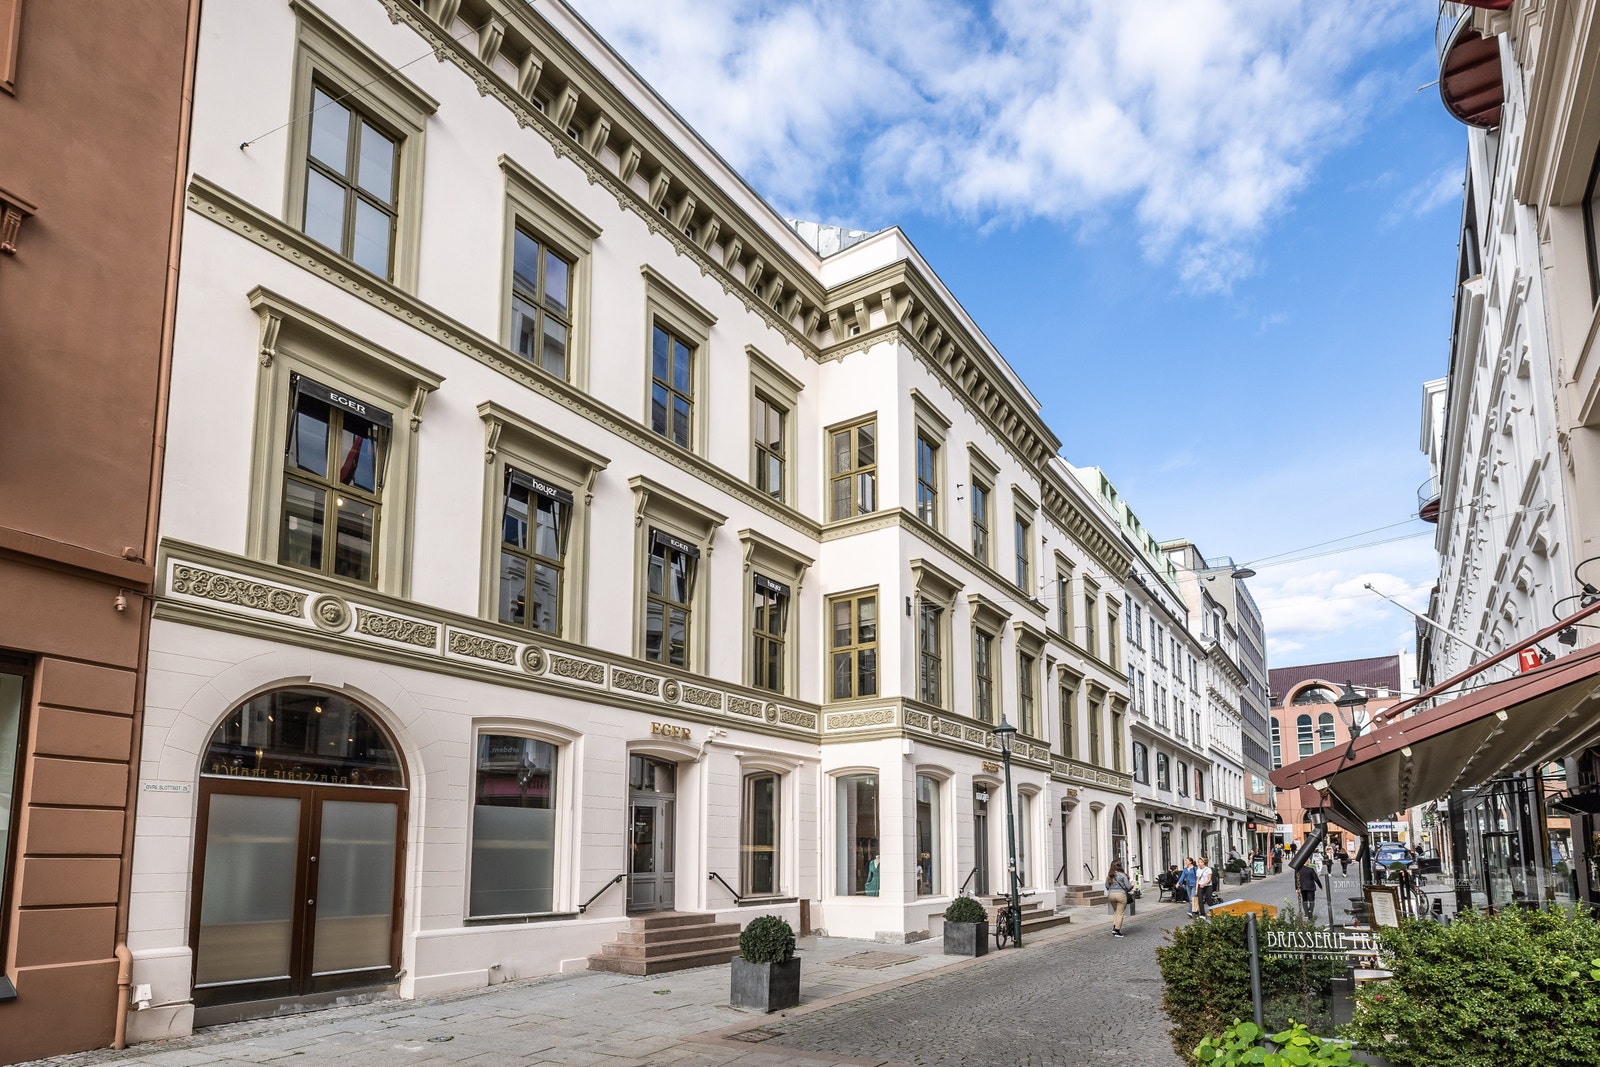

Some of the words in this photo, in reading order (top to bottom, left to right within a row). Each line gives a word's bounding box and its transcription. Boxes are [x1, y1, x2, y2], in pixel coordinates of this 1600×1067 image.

[330, 393, 366, 415] EGER
[670, 539, 689, 552] EGER
[651, 721, 691, 740] EGER
[1267, 931, 1348, 949] BRASSERIE
